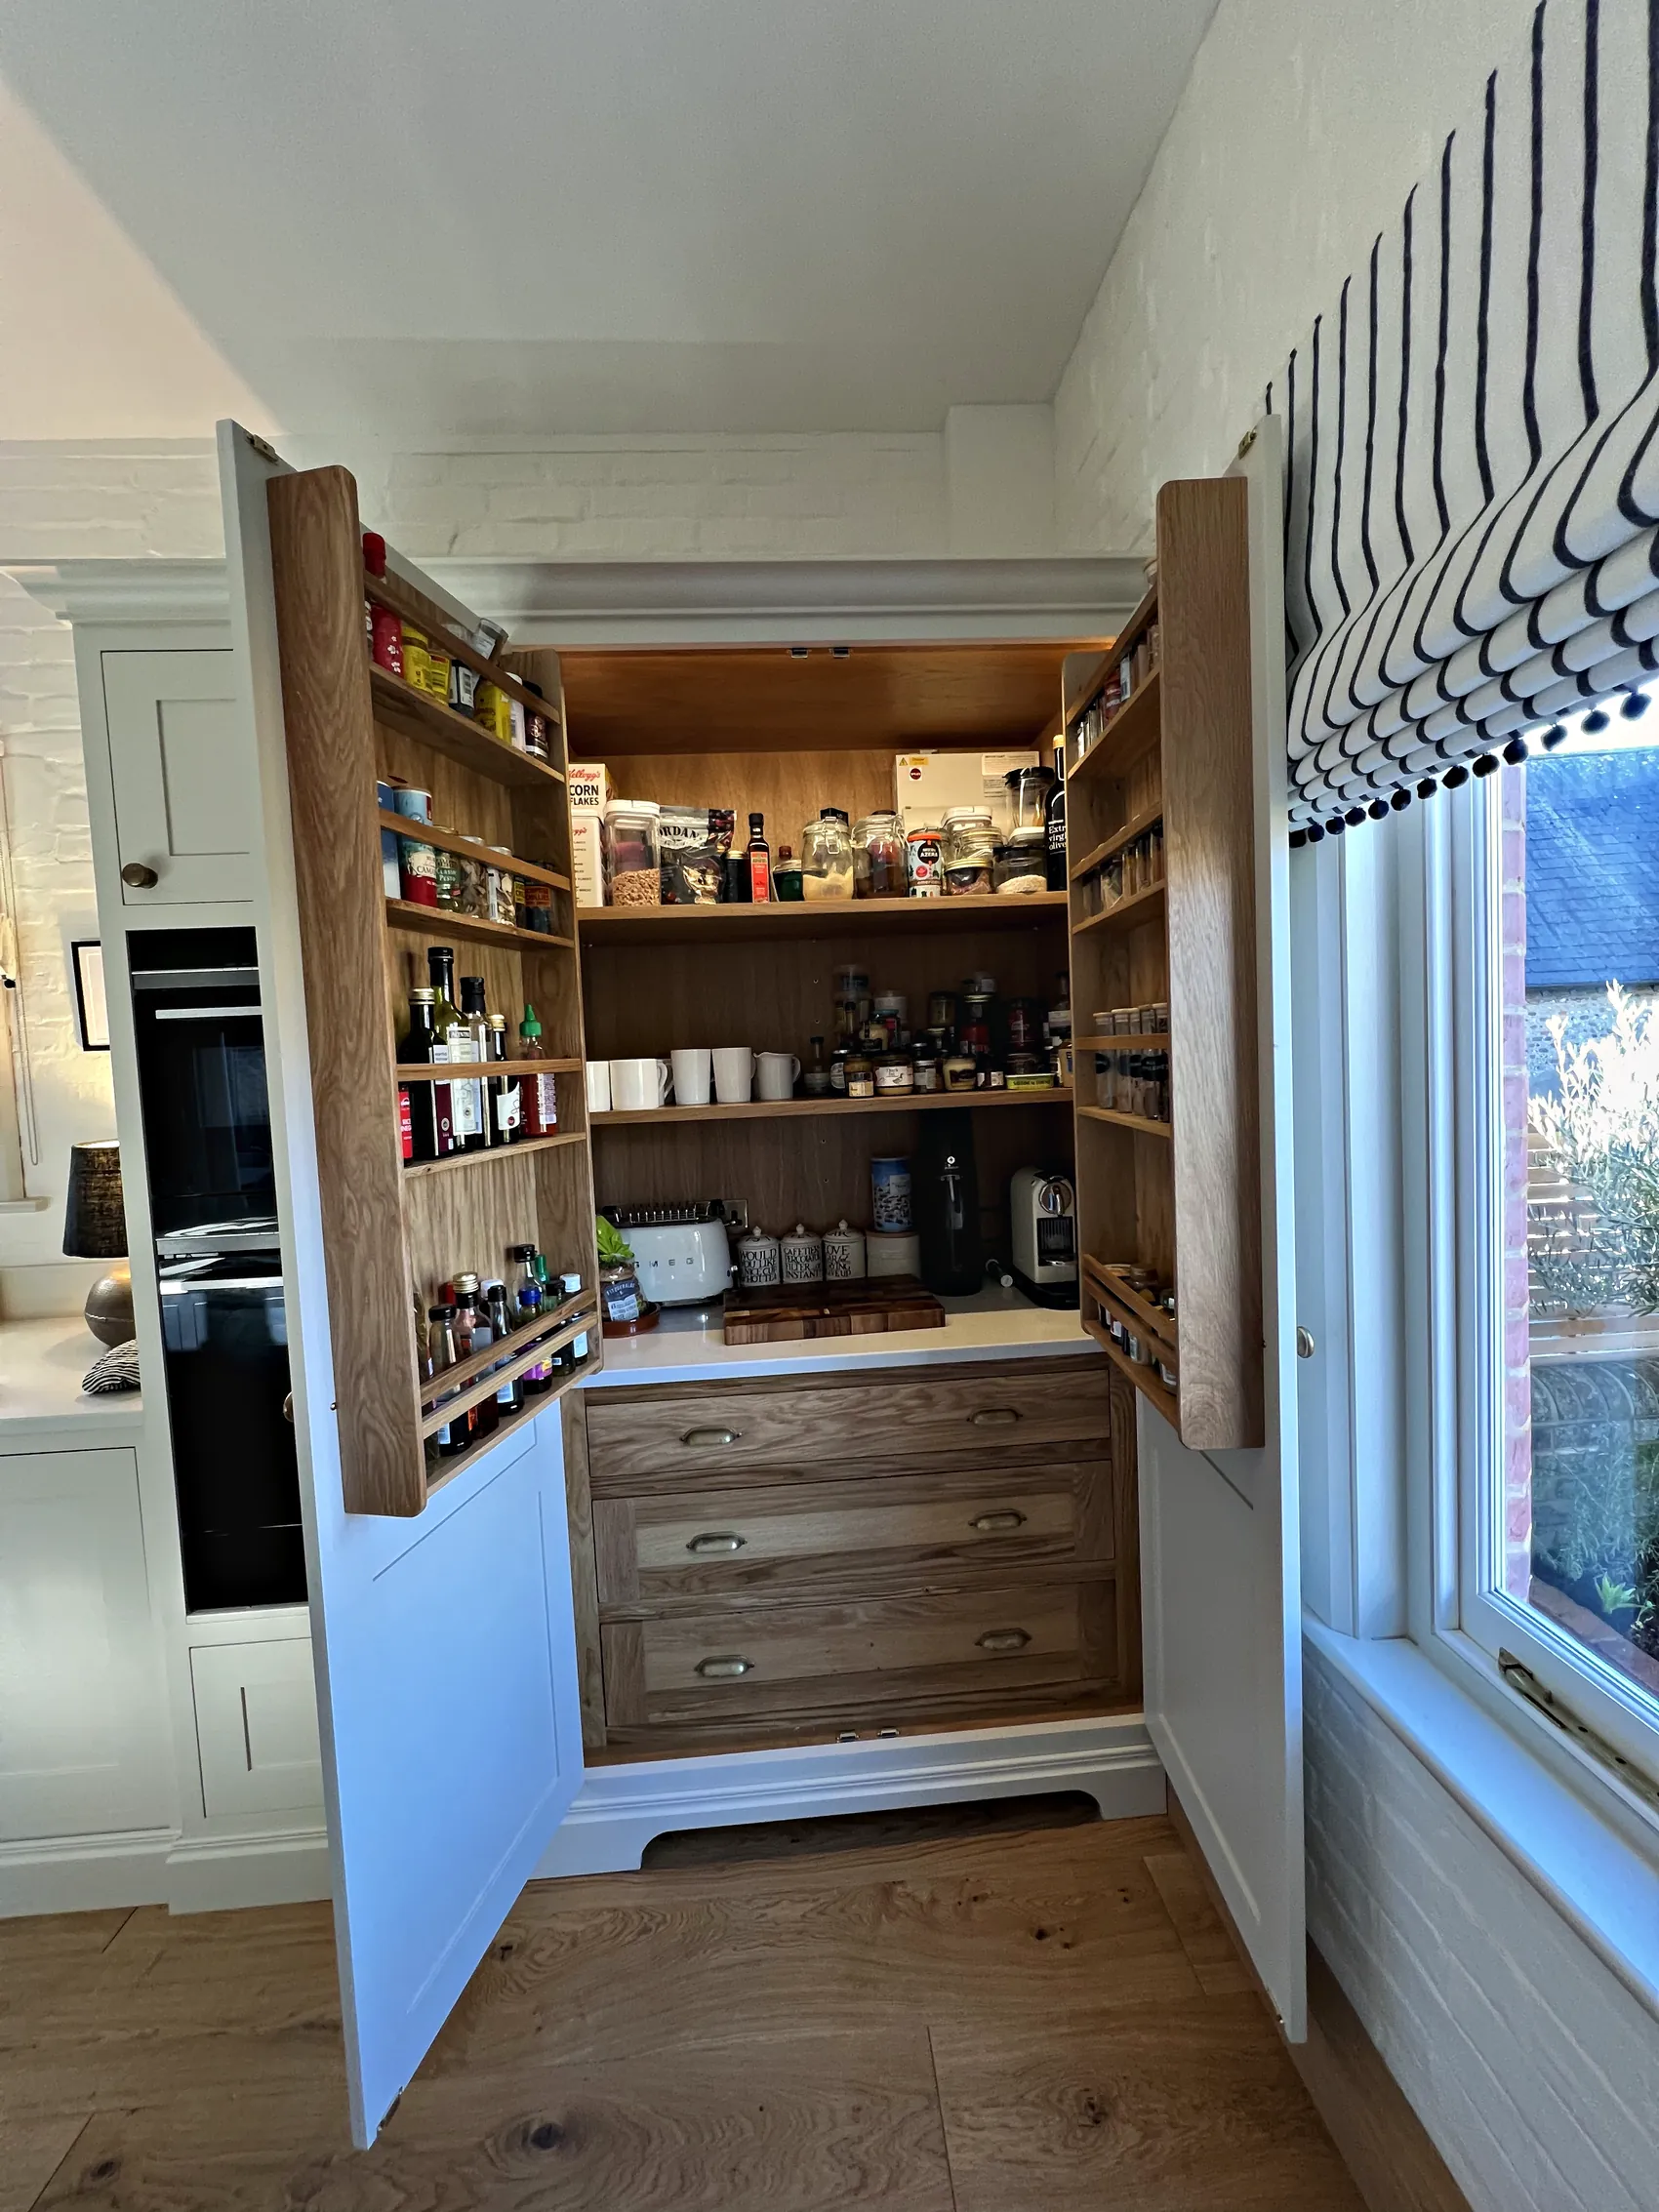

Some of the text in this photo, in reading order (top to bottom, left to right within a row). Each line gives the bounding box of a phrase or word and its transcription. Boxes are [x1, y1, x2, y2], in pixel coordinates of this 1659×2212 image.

[570, 784, 599, 796] CORN
[1048, 825, 1067, 834] Extr
[1048, 833, 1066, 842] virg
[740, 1249, 776, 1261] WOULD
[827, 1245, 851, 1256] OVE
[787, 1269, 820, 1278] INSTANT
